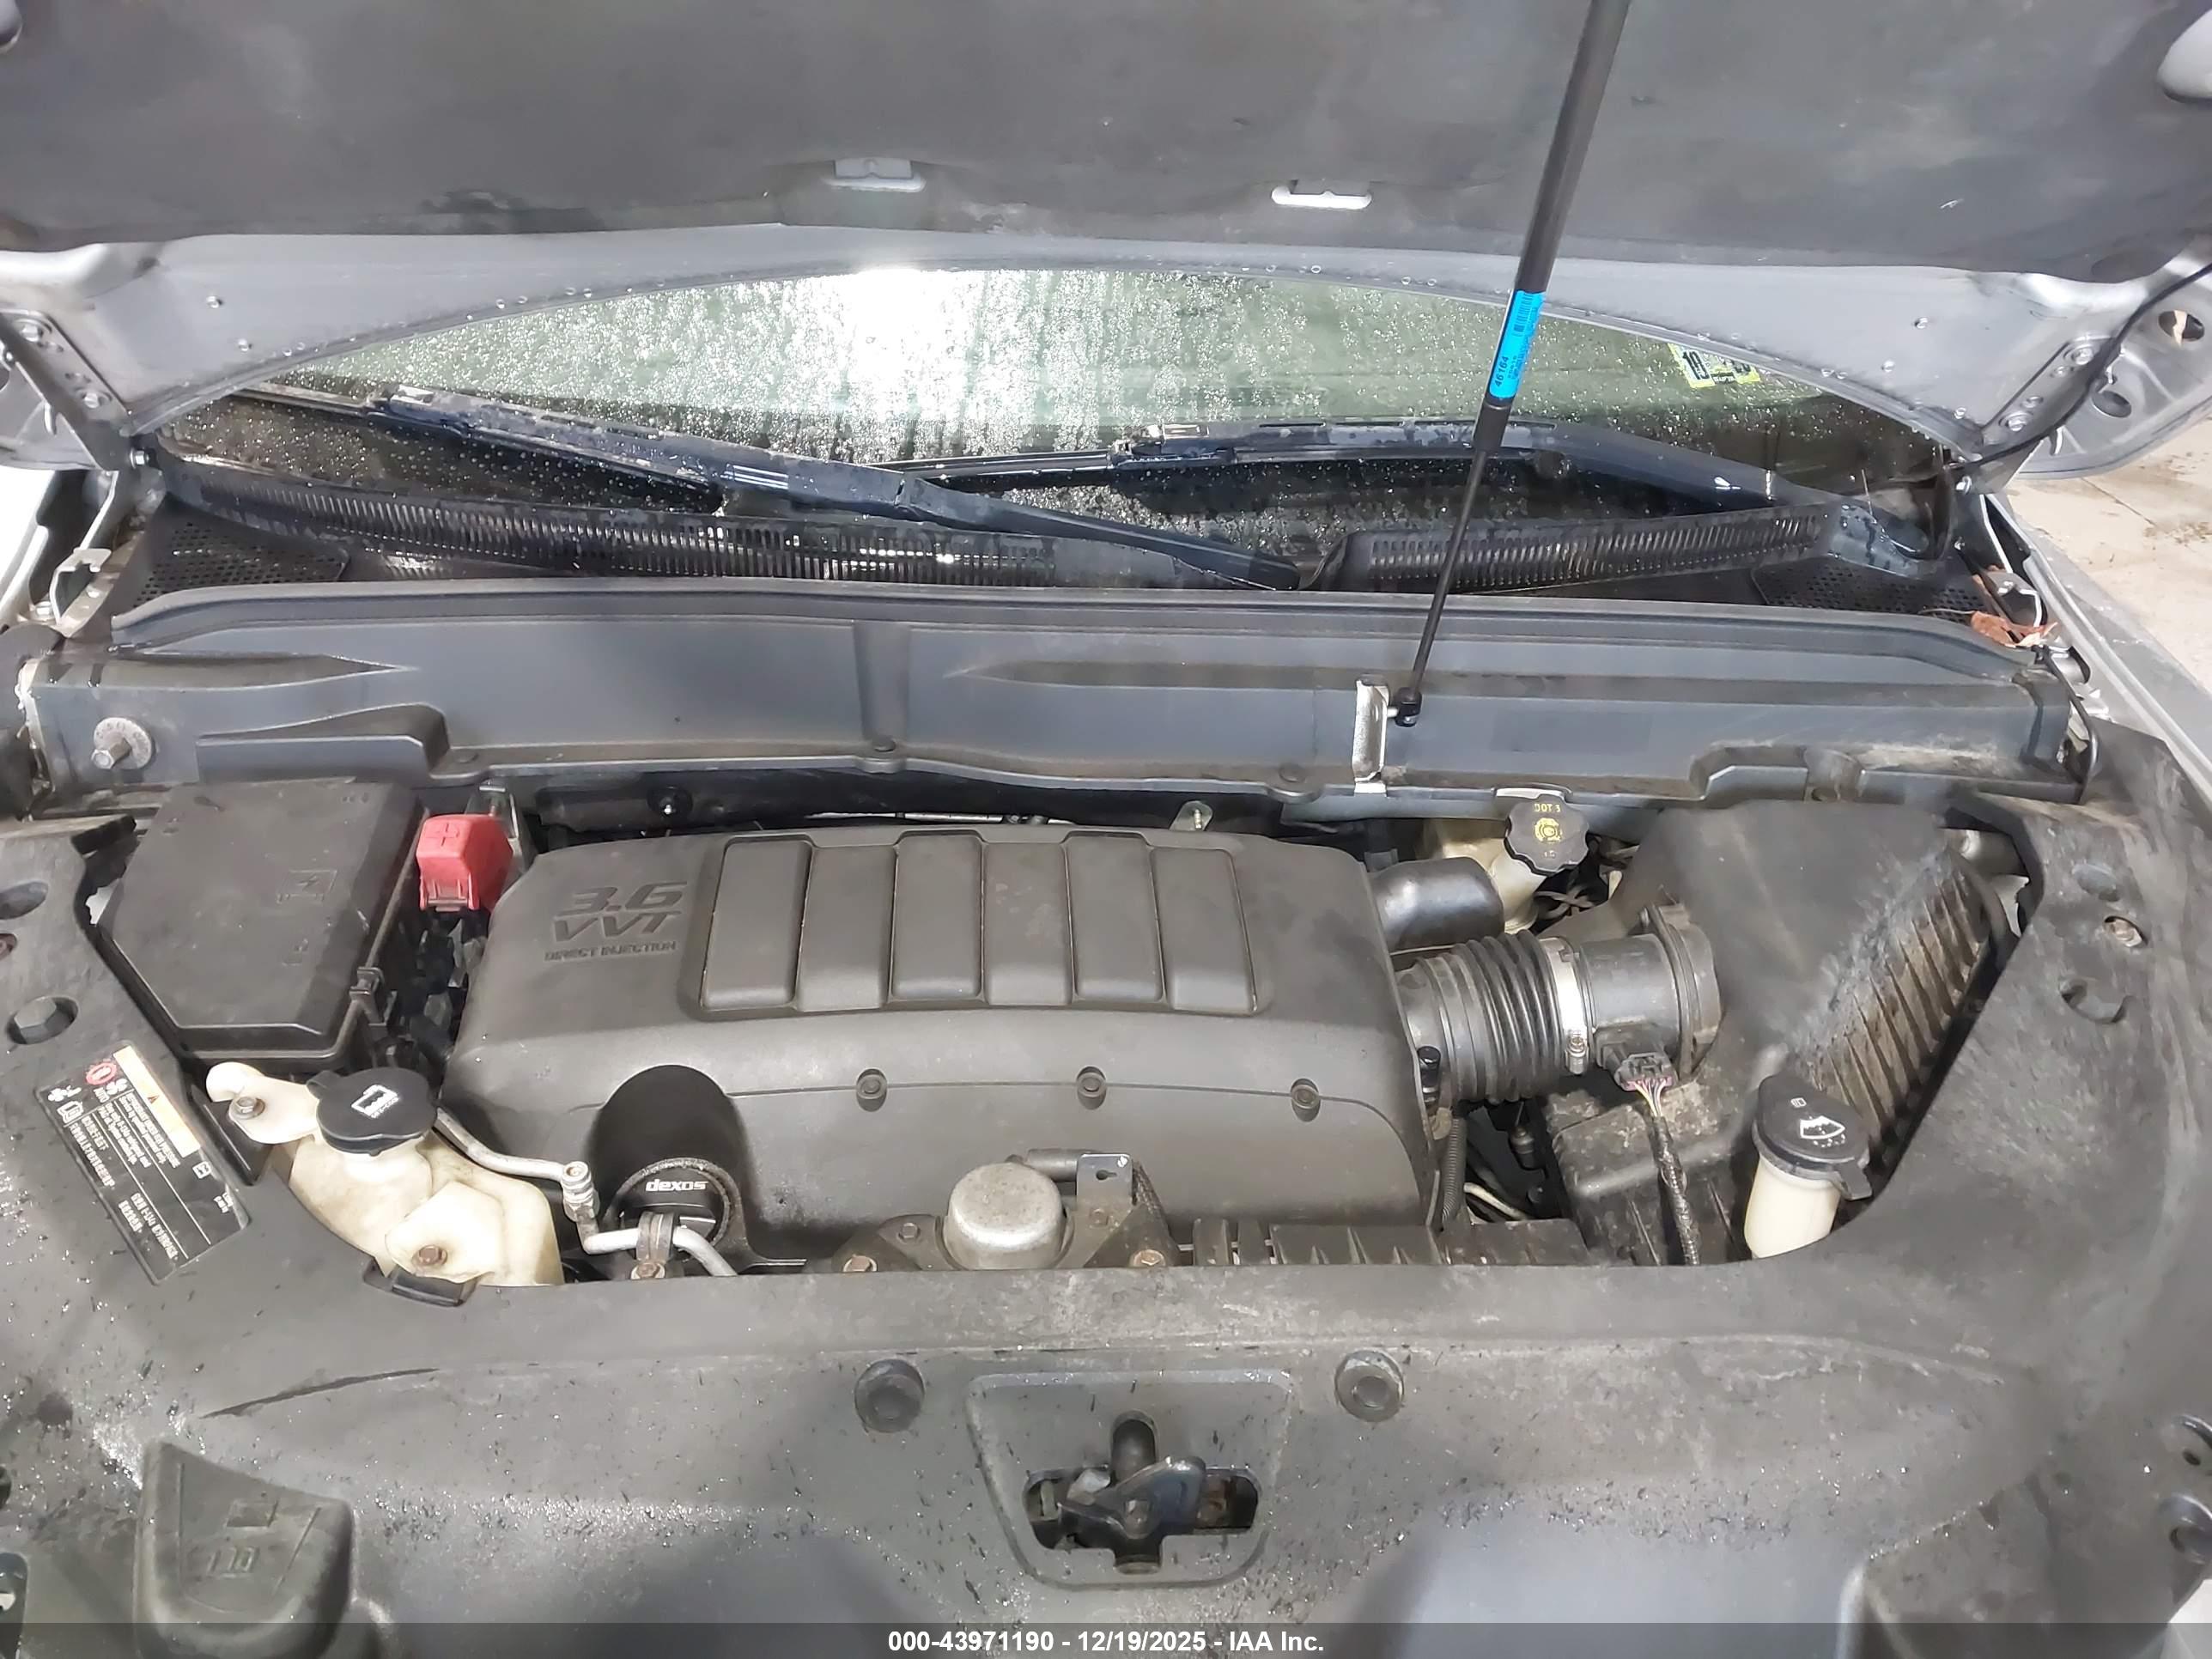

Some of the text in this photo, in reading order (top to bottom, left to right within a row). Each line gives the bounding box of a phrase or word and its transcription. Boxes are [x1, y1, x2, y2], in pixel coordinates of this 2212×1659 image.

[1495, 356, 1509, 387] 46164
[1534, 803, 1553, 812] DOT
[554, 881, 687, 919] 3.6
[554, 911, 682, 942] VVT
[544, 941, 677, 963] DIRECT INJECTION
[93, 1087, 109, 1103] AUTO
[646, 1179, 709, 1192] dexos
